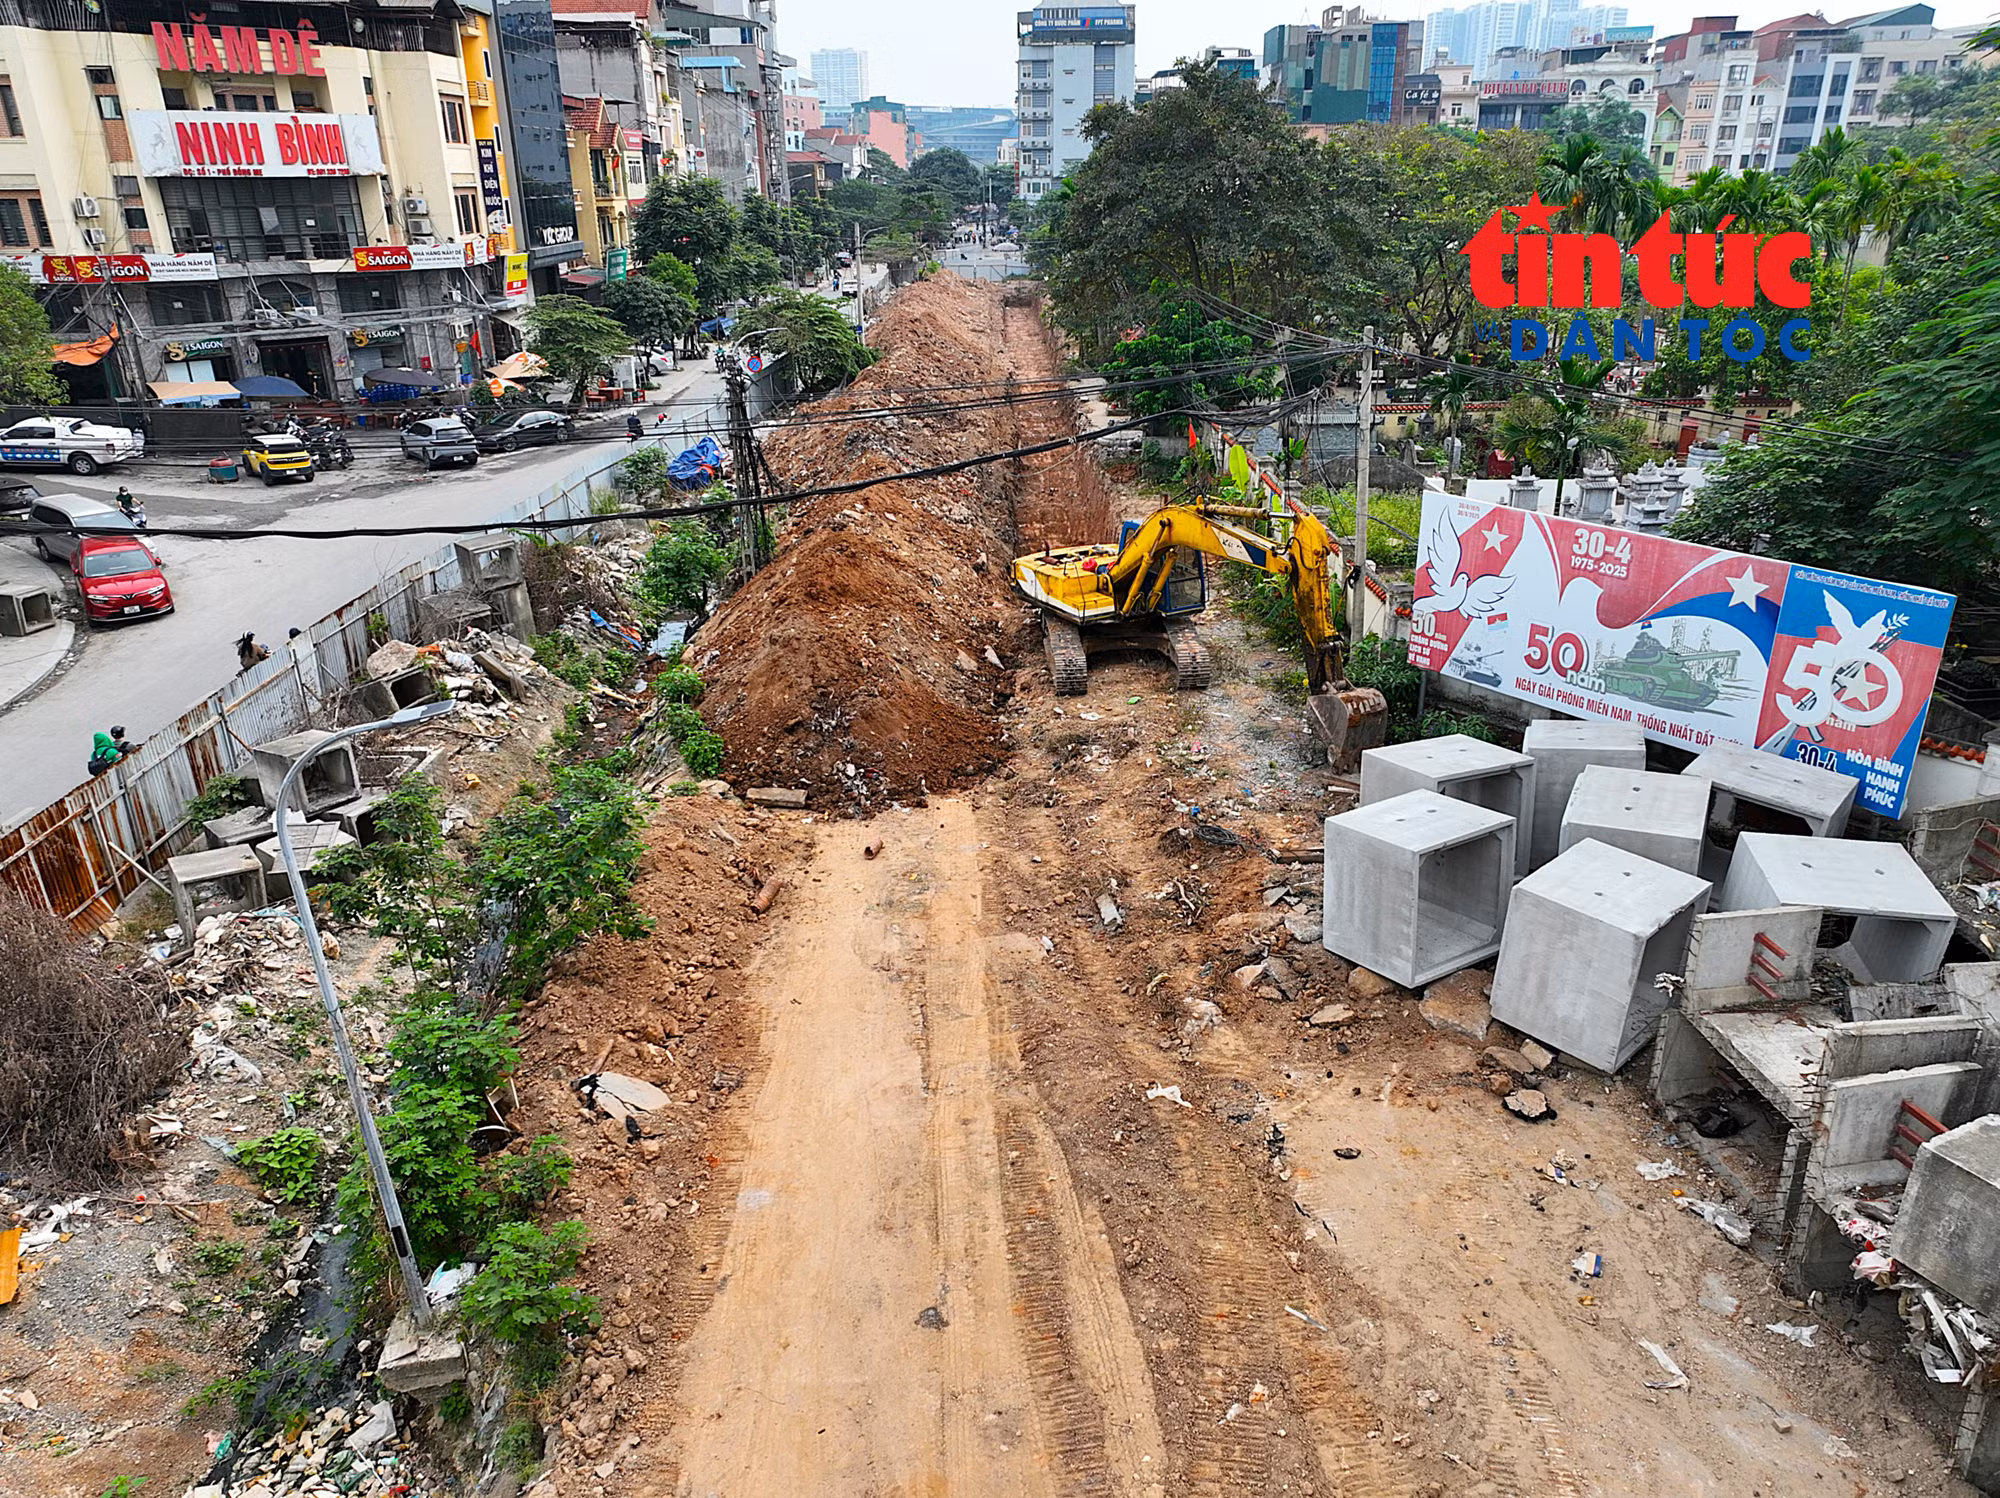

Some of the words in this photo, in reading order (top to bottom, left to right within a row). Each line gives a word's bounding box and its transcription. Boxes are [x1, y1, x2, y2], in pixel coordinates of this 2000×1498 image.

[150, 8, 264, 75] NĂM
[268, 18, 326, 77] DÊ
[1540, 82, 1567, 94] CLUB
[175, 122, 265, 166] NINH
[275, 116, 346, 166] BÌNH
[480, 148, 492, 158] KIM
[483, 162, 494, 173] KHÍ
[485, 178, 498, 191] ĐIỆN
[486, 194, 502, 206] NƯỚC
[554, 226, 573, 243] GROUP
[93, 265, 144, 277] SIGON
[204, 258, 214, 266] DÊ
[368, 255, 408, 266] SAIGON
[190, 341, 223, 351] SAIGON
[1572, 528, 1631, 564] 30-4
[1571, 556, 1627, 577] 1975-2025
[1412, 609, 1436, 637] 50
[1522, 622, 1586, 678] 50
[1565, 669, 1607, 694] năm
[1776, 641, 1903, 727] 50
[1515, 676, 1536, 694] NGÀY
[1538, 682, 1554, 700] GIẢI
[1556, 688, 1584, 709] PHÓNG
[1586, 698, 1609, 717] MIỀN
[1637, 712, 1666, 733] THỐNG
[1668, 722, 1693, 742] NHẤT
[1695, 729, 1715, 747] ĐẤT
[1796, 743, 1837, 773] 30-4
[1846, 748, 1872, 768] HÒA
[1874, 755, 1904, 778] BÌNH
[1864, 787, 1896, 809] PHÚC
